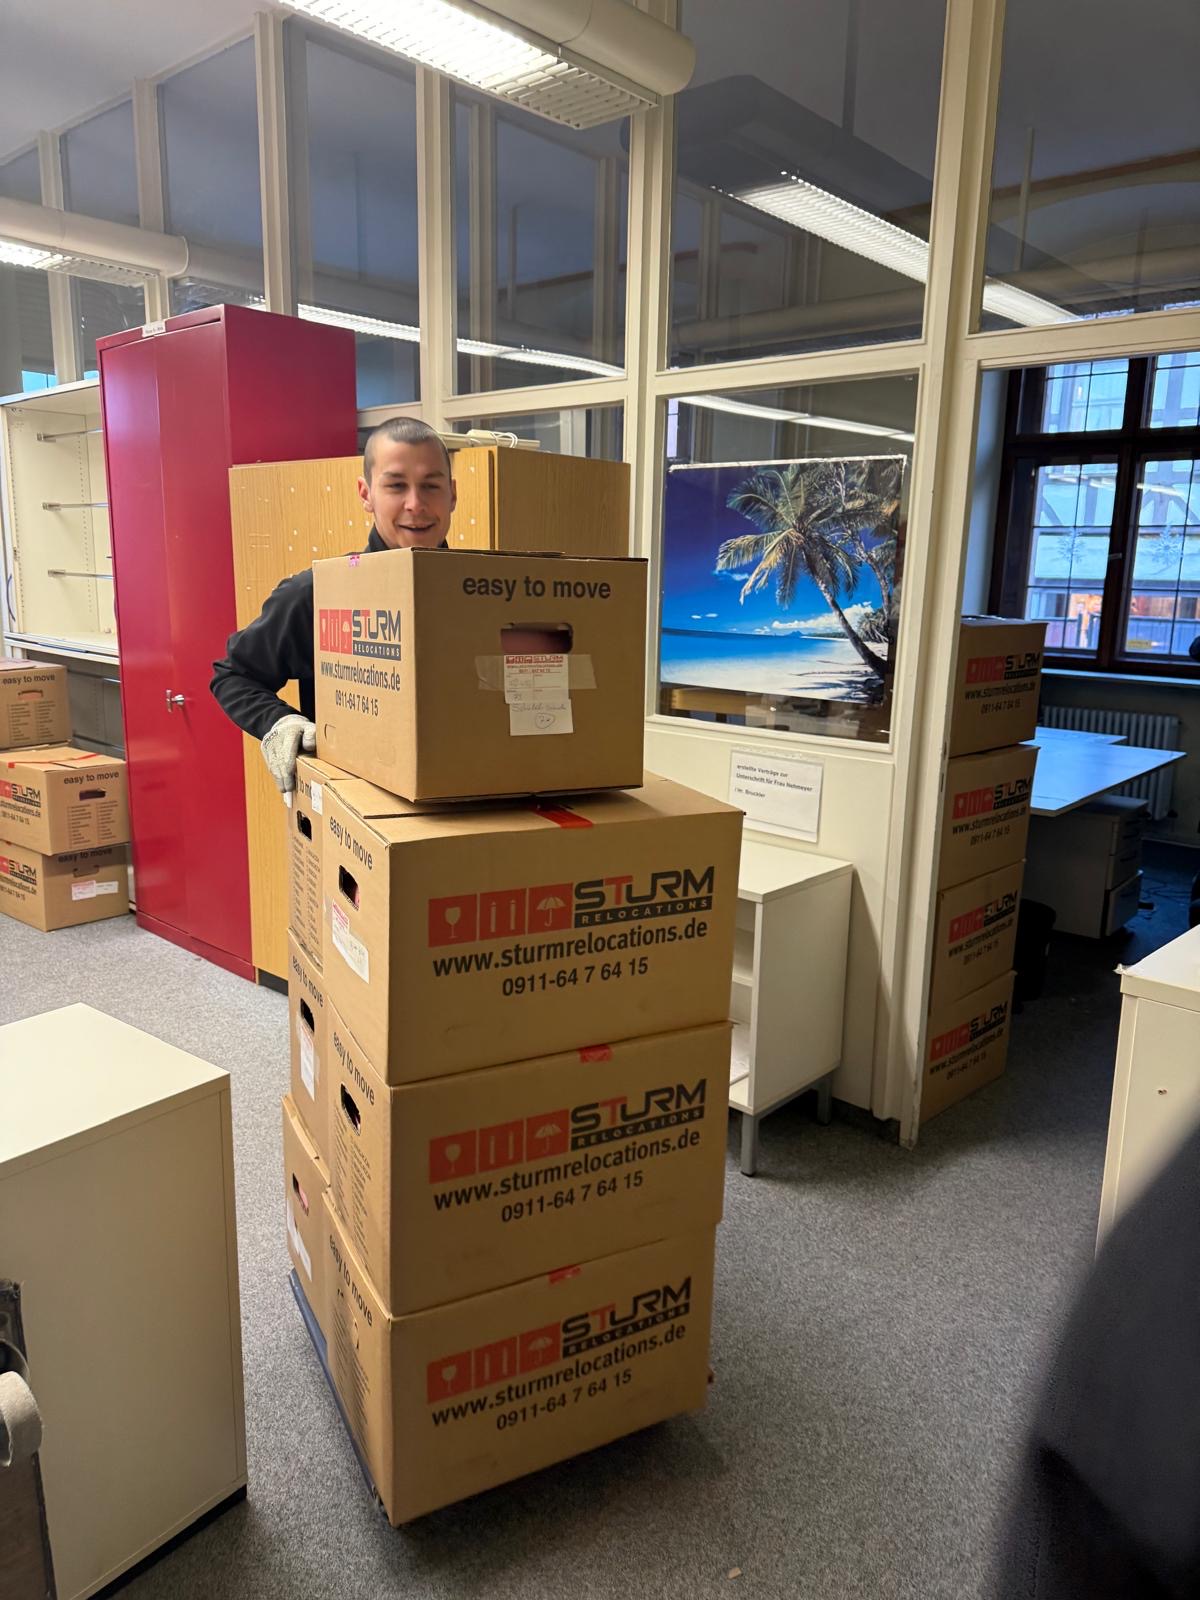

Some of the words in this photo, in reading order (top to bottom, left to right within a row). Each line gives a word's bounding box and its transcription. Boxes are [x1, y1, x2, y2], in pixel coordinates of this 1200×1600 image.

[463, 576, 517, 602] easy
[524, 577, 546, 598] to
[553, 580, 611, 599] move
[352, 609, 401, 642] STURM
[354, 643, 401, 659] RELOCATIONS
[2, 675, 22, 685] easy
[24, 674, 33, 683] to
[34, 673, 55, 682] move
[321, 660, 401, 691] www.sturmrelocations.de
[357, 695, 361, 711] 7
[362, 696, 369, 714] 64
[371, 699, 379, 717] 15
[63, 776, 84, 785] easy
[97, 771, 119, 780] move
[330, 816, 343, 846] easy
[345, 827, 351, 850] to
[353, 838, 373, 871] move
[574, 865, 715, 912] STURM
[581, 899, 710, 925] RELOCATIONS
[433, 917, 708, 977] www.sturmrelocations.de
[502, 968, 579, 997] 0911-64
[585, 966, 596, 983] 7
[601, 961, 622, 980] 64
[628, 957, 648, 976] 15
[334, 1032, 346, 1066] easy
[347, 1050, 353, 1075] to
[354, 1066, 375, 1106] move
[571, 1079, 707, 1134] STURM
[577, 1109, 702, 1148] RELOCATIONS
[433, 1128, 700, 1211] www.sturmrelocations.de
[502, 1191, 575, 1222] 0911-64
[581, 1184, 592, 1202] 7
[597, 1178, 617, 1197] 64
[624, 1170, 644, 1189] 15
[343, 1262, 351, 1287] to
[351, 1281, 373, 1327] move
[562, 1276, 692, 1343] STURM
[431, 1323, 686, 1428] www.sturmrelocations.de
[496, 1394, 567, 1431] 0911-64
[572, 1385, 583, 1403] 7
[587, 1379, 608, 1398] 64
[613, 1369, 632, 1389] 15
